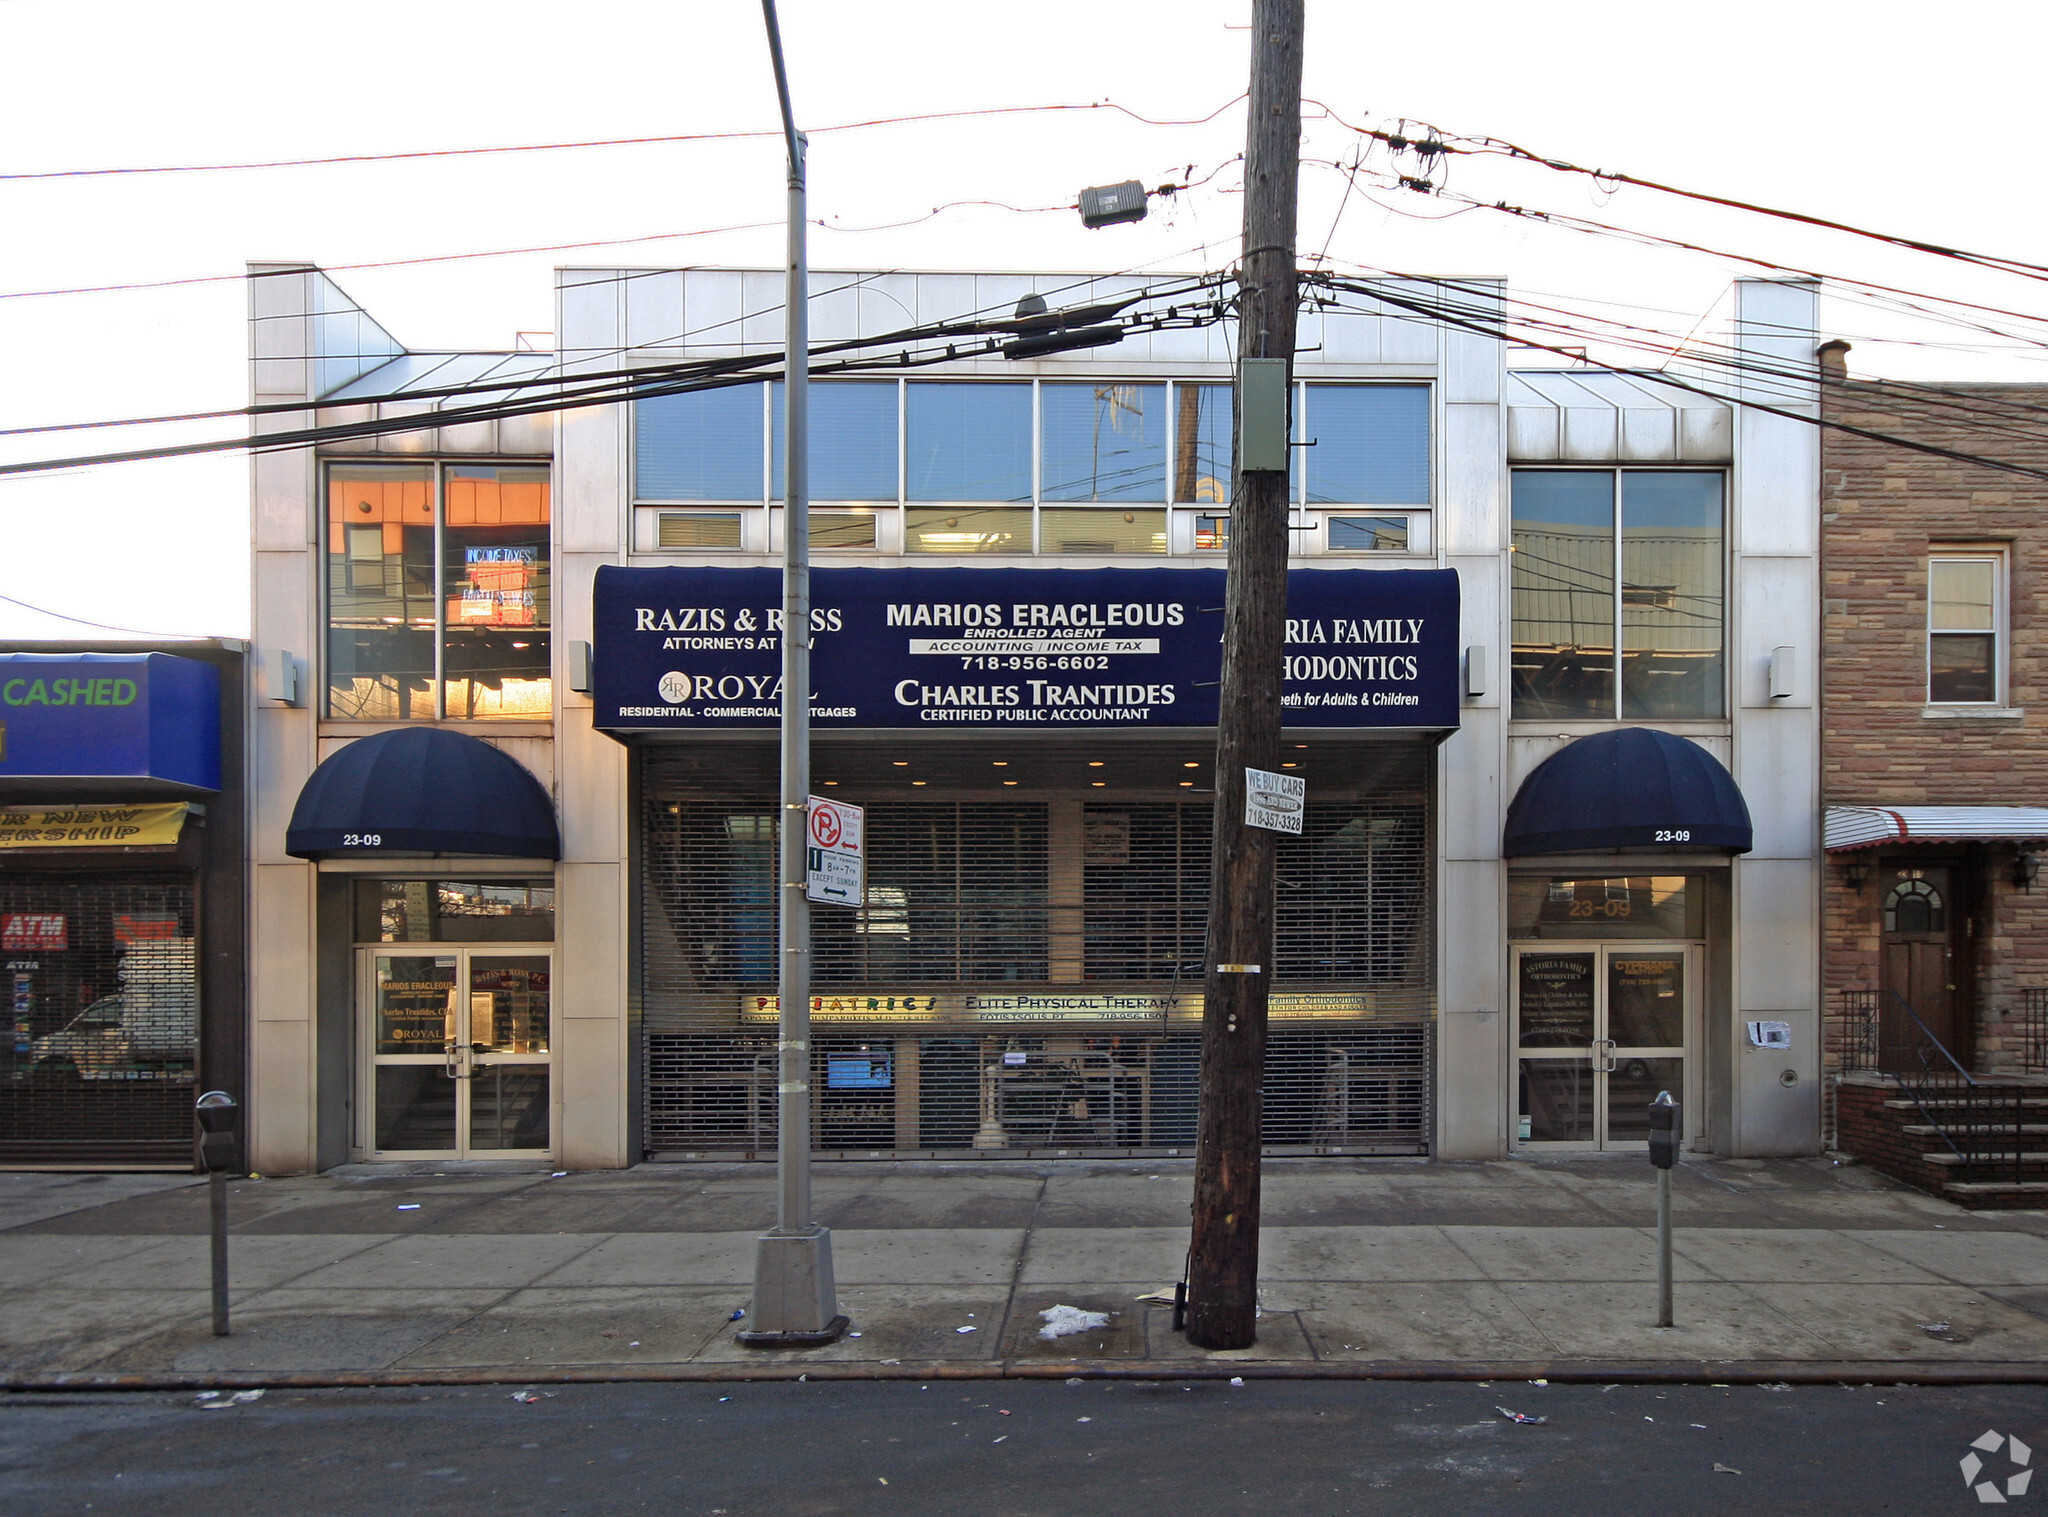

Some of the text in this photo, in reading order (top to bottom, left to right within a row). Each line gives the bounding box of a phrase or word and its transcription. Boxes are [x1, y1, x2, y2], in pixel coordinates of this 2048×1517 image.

[467, 549, 532, 564] INCOME TAXES
[635, 608, 843, 632] RAZIS & RSS
[886, 603, 1185, 626] MARIOS ERACLEOUS
[963, 628, 1106, 639] ENROLLED AGENT
[1332, 619, 1424, 644] FAMILY
[662, 637, 755, 650] ATTORNEYS
[757, 637, 777, 650] AT
[928, 641, 1034, 652] ACCOUNTING
[1046, 641, 1110, 652] INCOME
[1114, 641, 1143, 652] TAX
[960, 656, 1110, 670] 718-956-6602
[1282, 656, 1418, 680] HODONTICS
[2, 678, 138, 706] CASHED
[1304, 692, 1321, 706] for
[1322, 692, 1358, 706] Adults
[1361, 693, 1369, 706] &
[1372, 692, 1419, 706] Children
[619, 707, 694, 717] RESIDENTIAL
[705, 707, 782, 717] COMMERCIAL
[808, 707, 857, 717] TGAGES
[920, 708, 1150, 721] CERTIFIED PUBLIC ACCOUNTANT
[1248, 770, 1304, 797] WE BUY CARS
[42, 809, 143, 825] NEW
[1248, 809, 1301, 831] 718-357-3328
[343, 834, 382, 846] 23-09
[1654, 830, 1690, 842] 23-09
[813, 850, 818, 869] 1
[812, 872, 858, 887] EXCEPT SUNDAY
[1568, 900, 1632, 918] 23-09
[4, 916, 64, 936] ATM
[1526, 961, 1588, 974] ASTORIA FAMILY
[382, 982, 454, 990] MARIOS ERACLEOUS
[756, 996, 938, 1011] PIATRICS
[966, 996, 1179, 1009] ELITE PHYSICAL THERAPY
[1269, 994, 1367, 1004] Family Orthodontics
[404, 1030, 442, 1038] ROYAL
